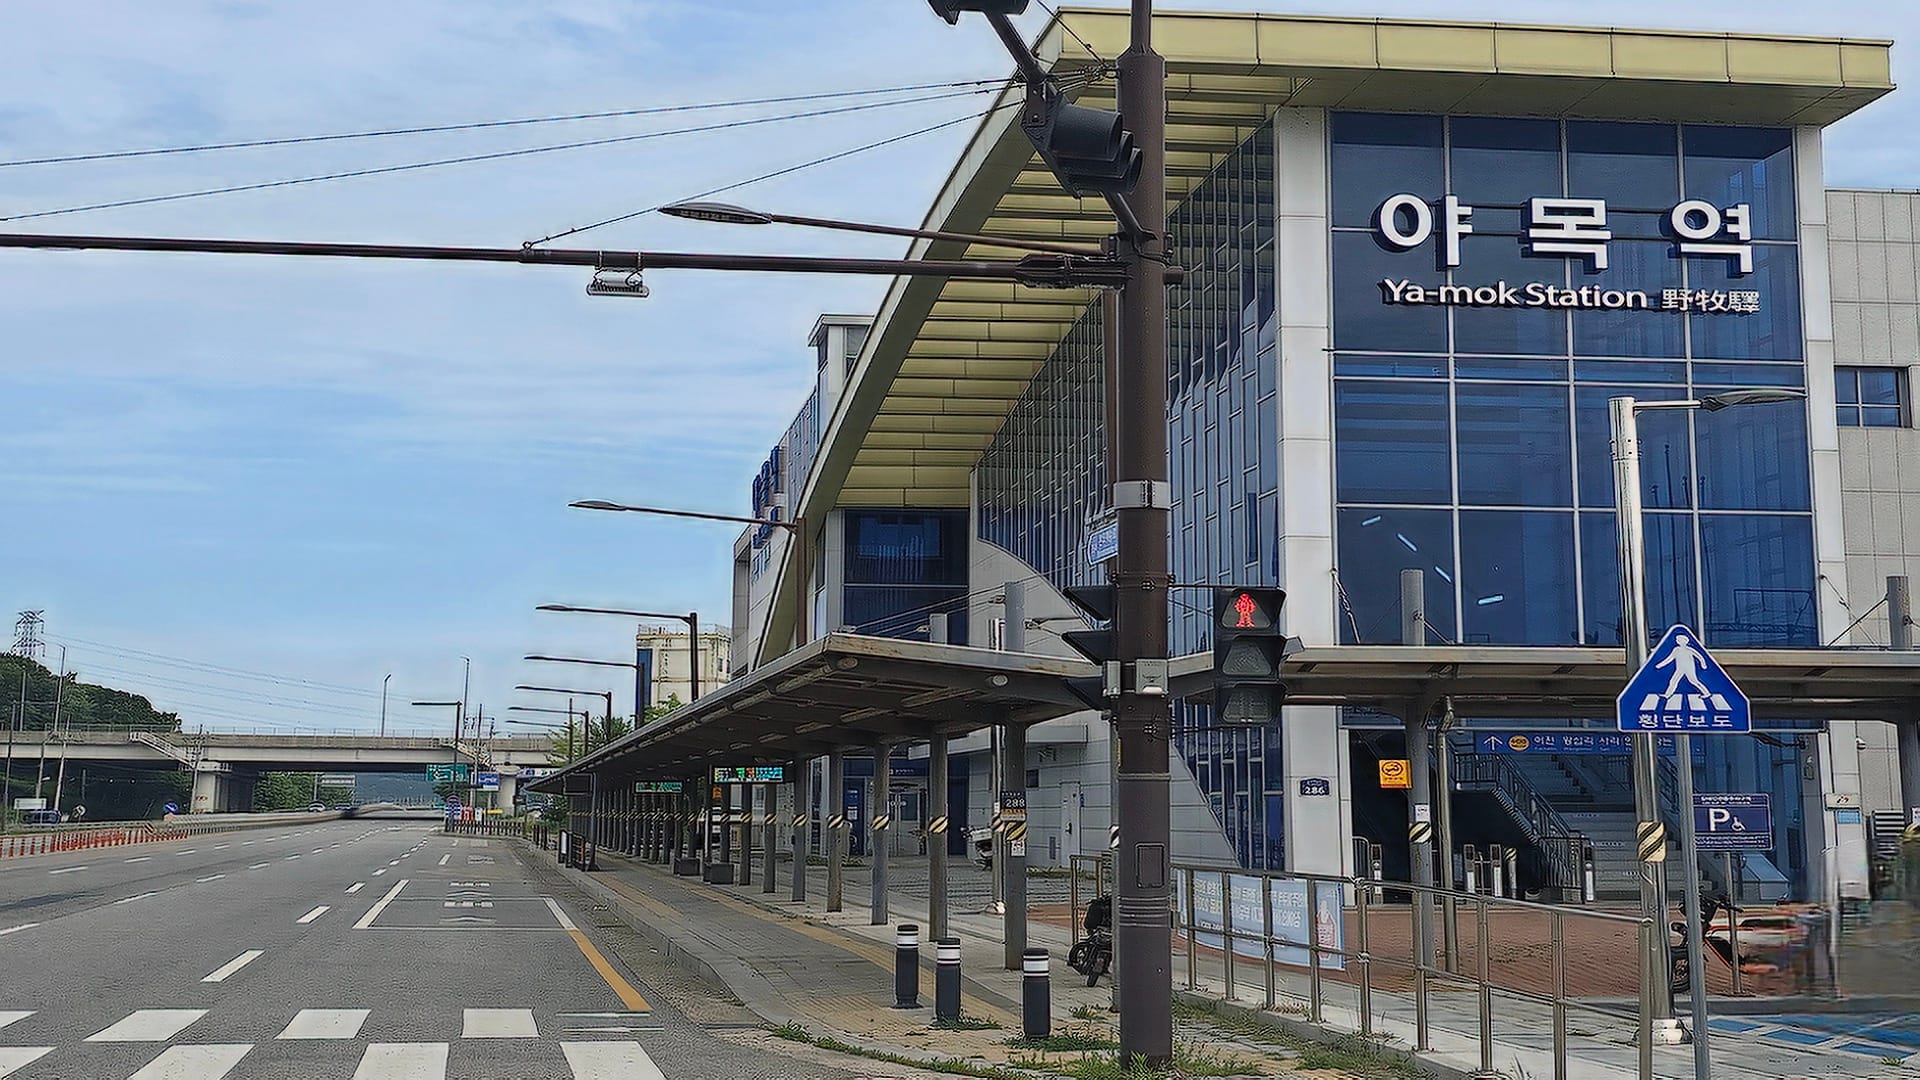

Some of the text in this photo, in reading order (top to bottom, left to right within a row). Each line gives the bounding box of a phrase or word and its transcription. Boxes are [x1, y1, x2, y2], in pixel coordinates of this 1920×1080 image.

[1379, 193, 1754, 273] 야목역
[1384, 279, 1648, 308] Ya-mok Station
[1661, 288, 1760, 313] 野牧驛
[1708, 807, 1731, 832] P
